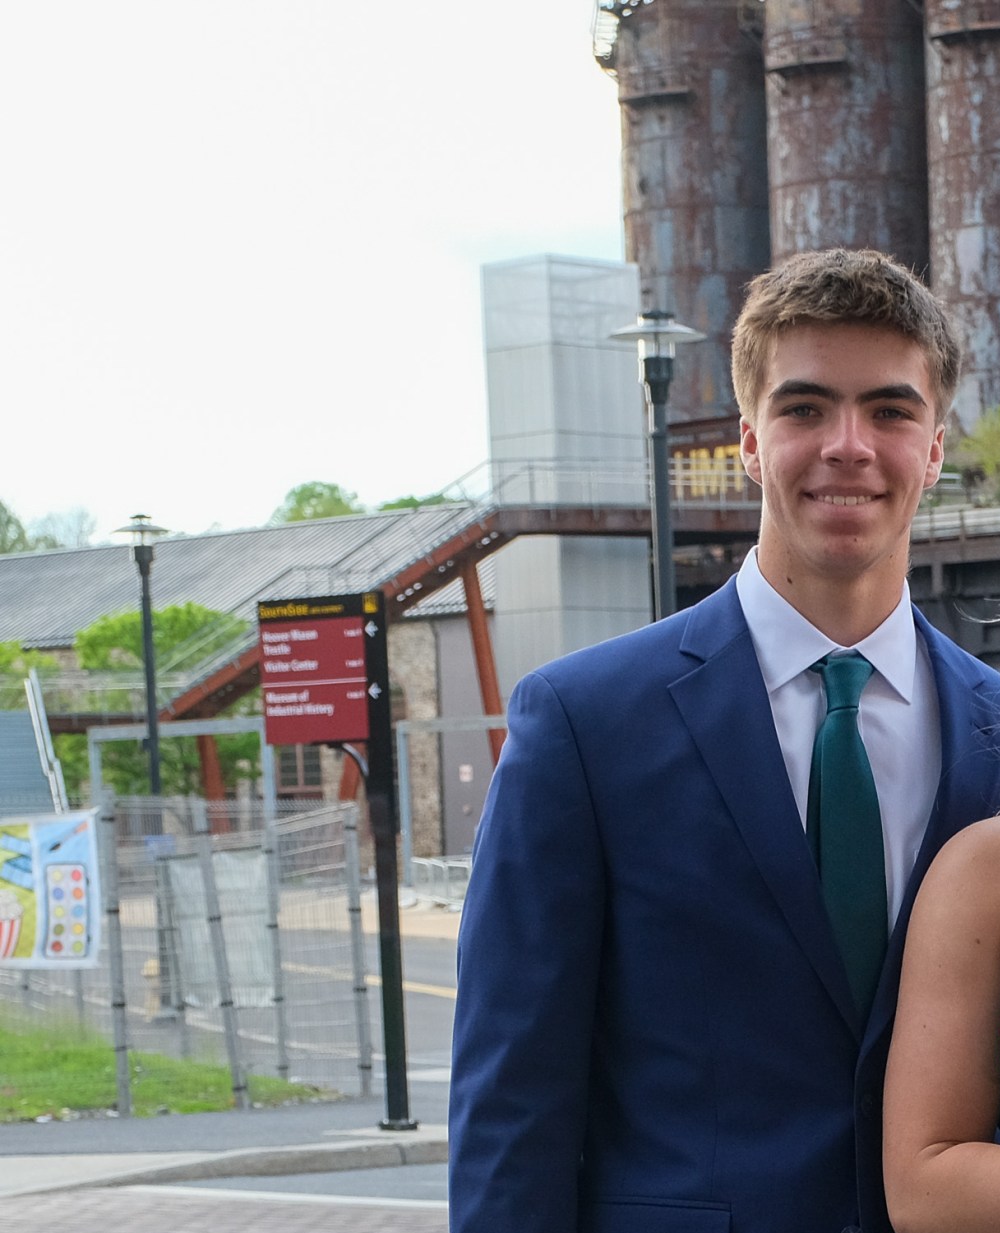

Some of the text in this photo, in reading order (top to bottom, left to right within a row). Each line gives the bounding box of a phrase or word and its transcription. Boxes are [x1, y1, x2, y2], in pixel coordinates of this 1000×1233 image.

[264, 659, 318, 673] Visitor Center
[266, 689, 309, 704] Museum of
[267, 703, 334, 717] Industrial History
